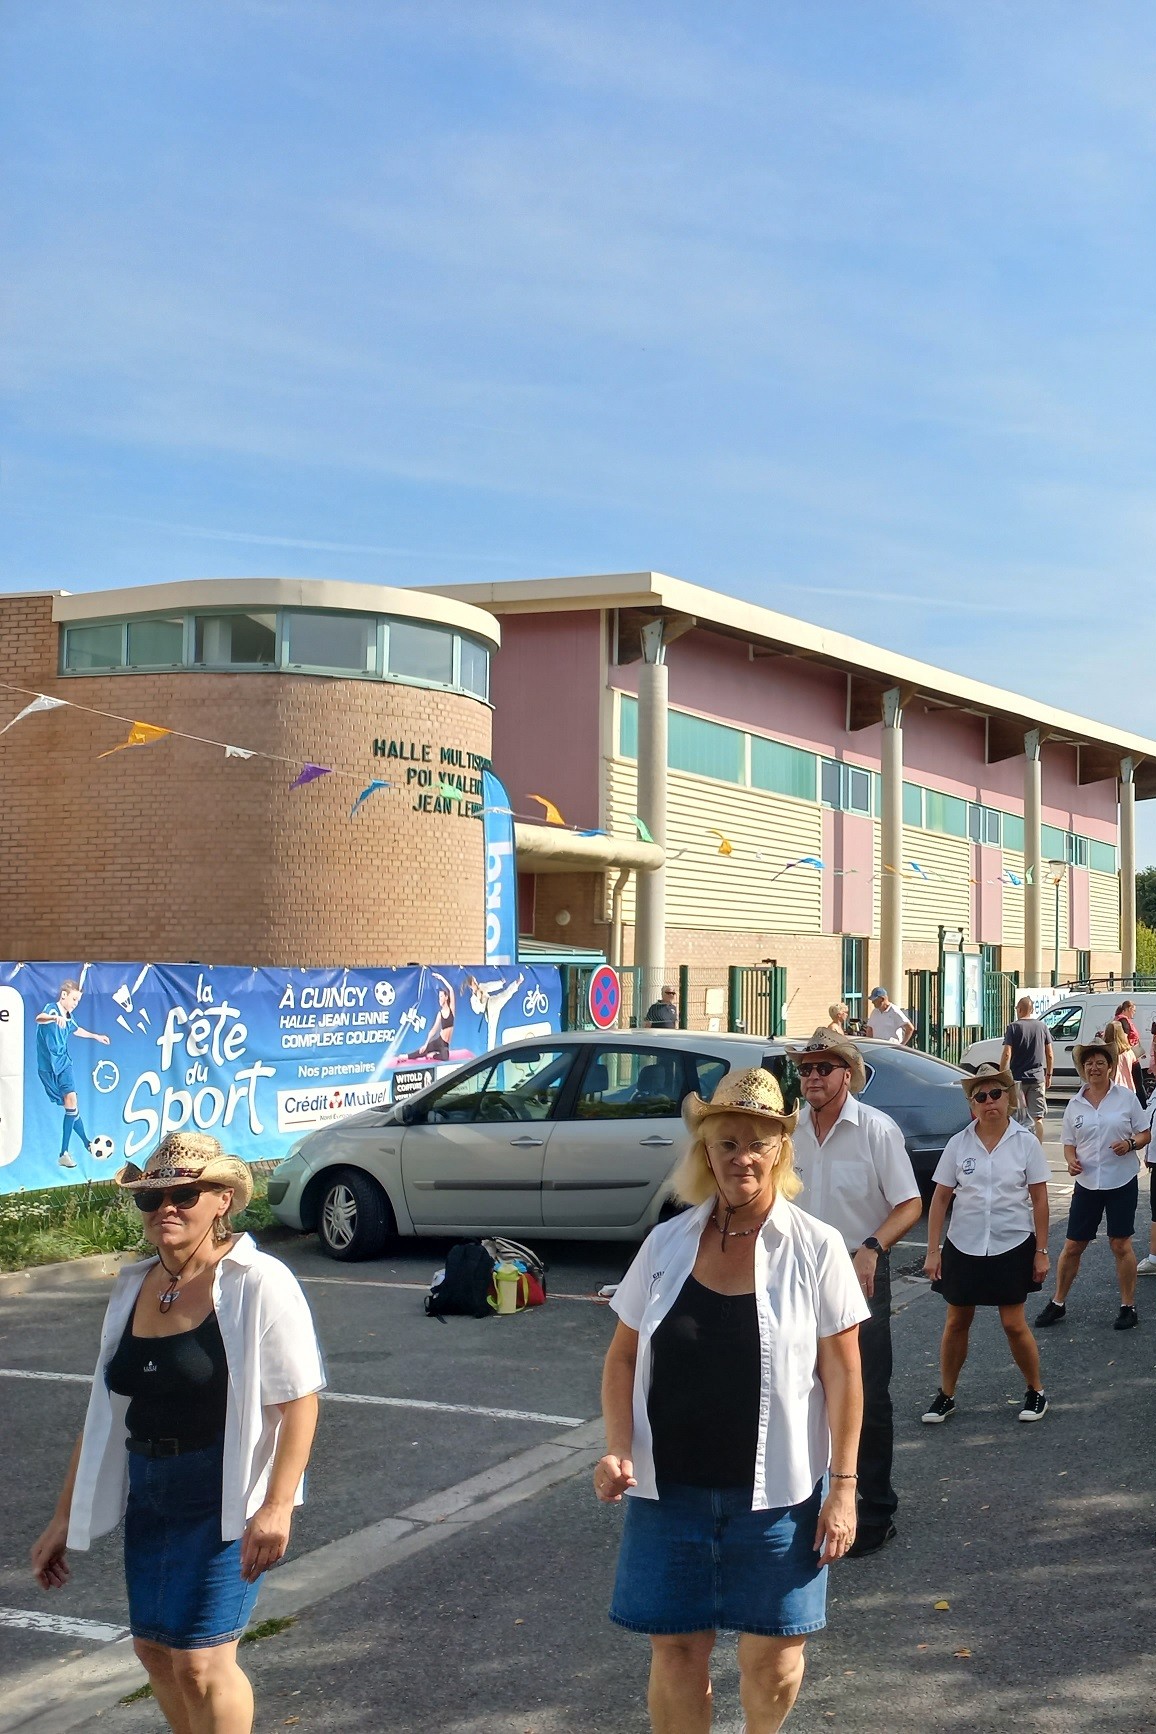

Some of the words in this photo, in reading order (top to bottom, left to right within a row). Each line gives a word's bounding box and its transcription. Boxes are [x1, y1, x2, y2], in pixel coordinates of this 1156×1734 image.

[373, 738, 432, 763] HALLE
[412, 793, 452, 815] JEAN
[197, 973, 214, 1003] la
[278, 983, 295, 1009] À
[300, 986, 368, 1009] CUINCY
[279, 1014, 316, 1029] HALLE
[318, 1012, 350, 1028] JEAN
[352, 1011, 389, 1026] LENNE
[156, 1000, 248, 1072] fête
[281, 1031, 344, 1049] COMPLEXE
[345, 1029, 396, 1045] COUDERC
[185, 1061, 209, 1086] du
[298, 1065, 320, 1078] Nos
[320, 1061, 376, 1079] partenaires
[395, 1072, 423, 1084] WITOLD
[123, 1060, 277, 1157] Sport
[284, 1094, 328, 1114] Crédit
[344, 1087, 387, 1108] Mutuel
